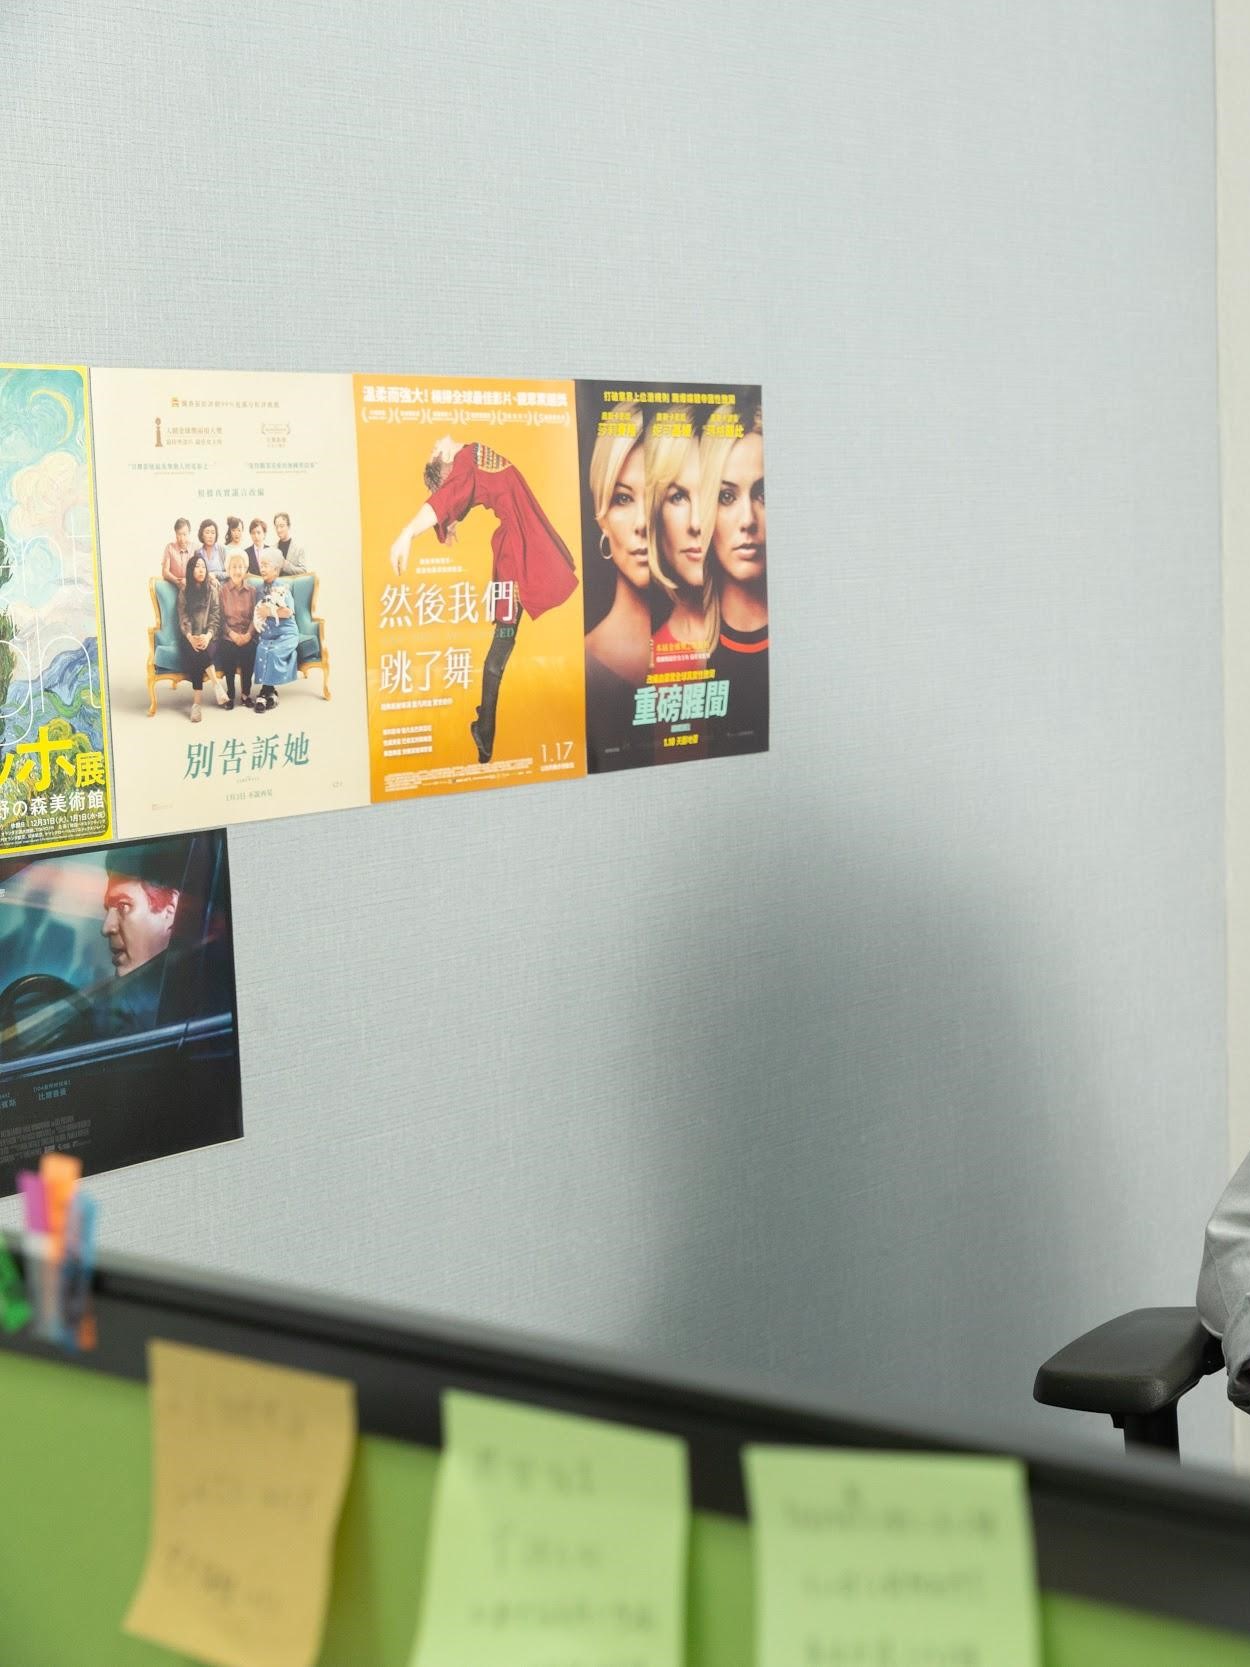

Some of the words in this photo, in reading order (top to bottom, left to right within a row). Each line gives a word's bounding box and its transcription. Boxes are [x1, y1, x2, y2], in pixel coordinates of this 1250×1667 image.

[379, 580, 514, 630] 然後我們
[379, 645, 473, 696] 跳了舞
[183, 731, 311, 781] 別告訴她
[541, 741, 575, 763] 1.17
